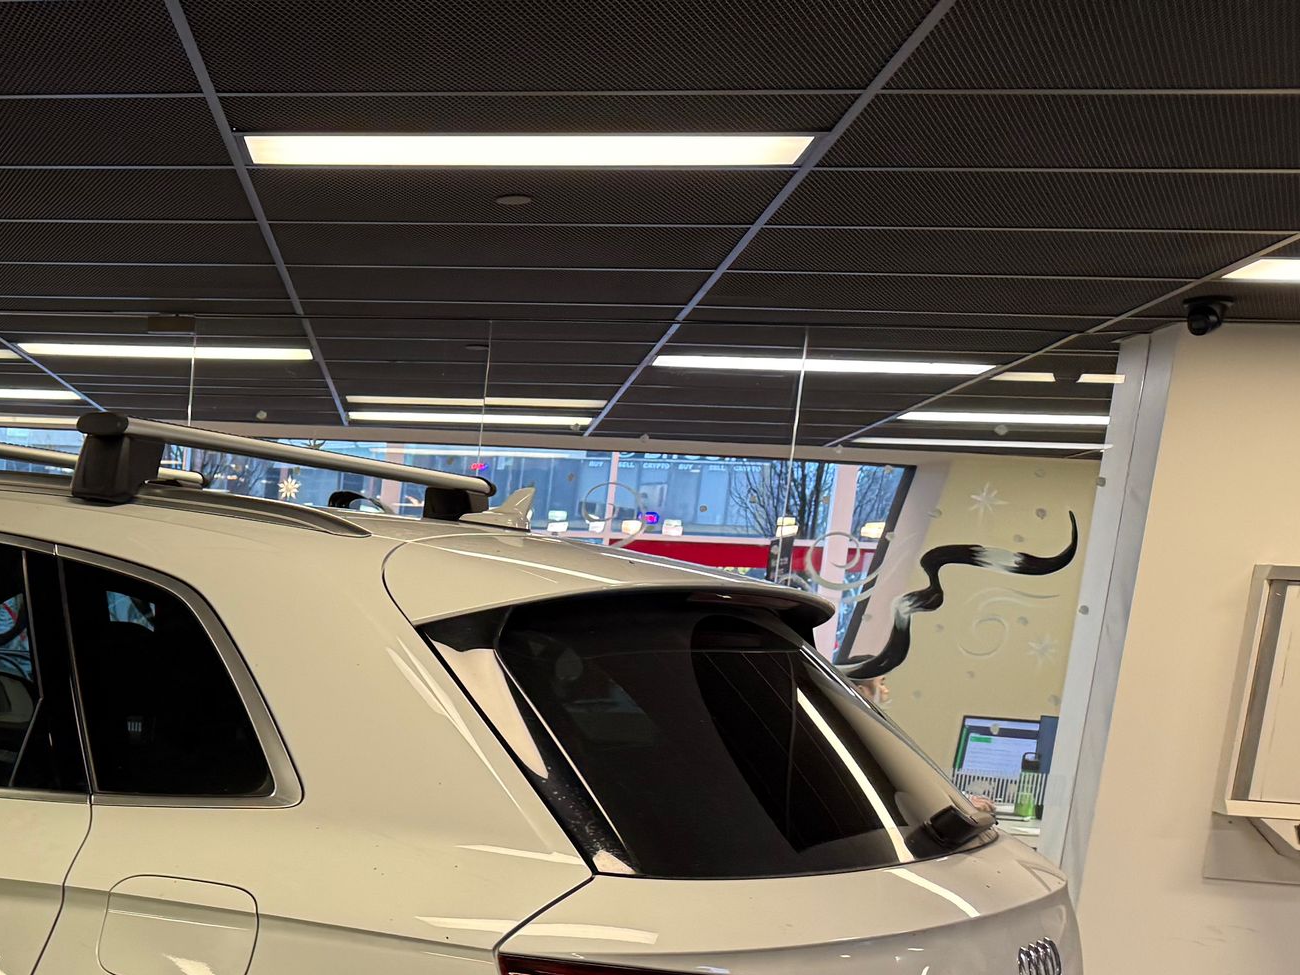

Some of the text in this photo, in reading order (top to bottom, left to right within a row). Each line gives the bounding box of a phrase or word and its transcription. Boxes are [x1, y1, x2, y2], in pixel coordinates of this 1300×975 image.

[588, 460, 762, 473] BUY SELL CRYPTO BUY SELL CRYPTO
